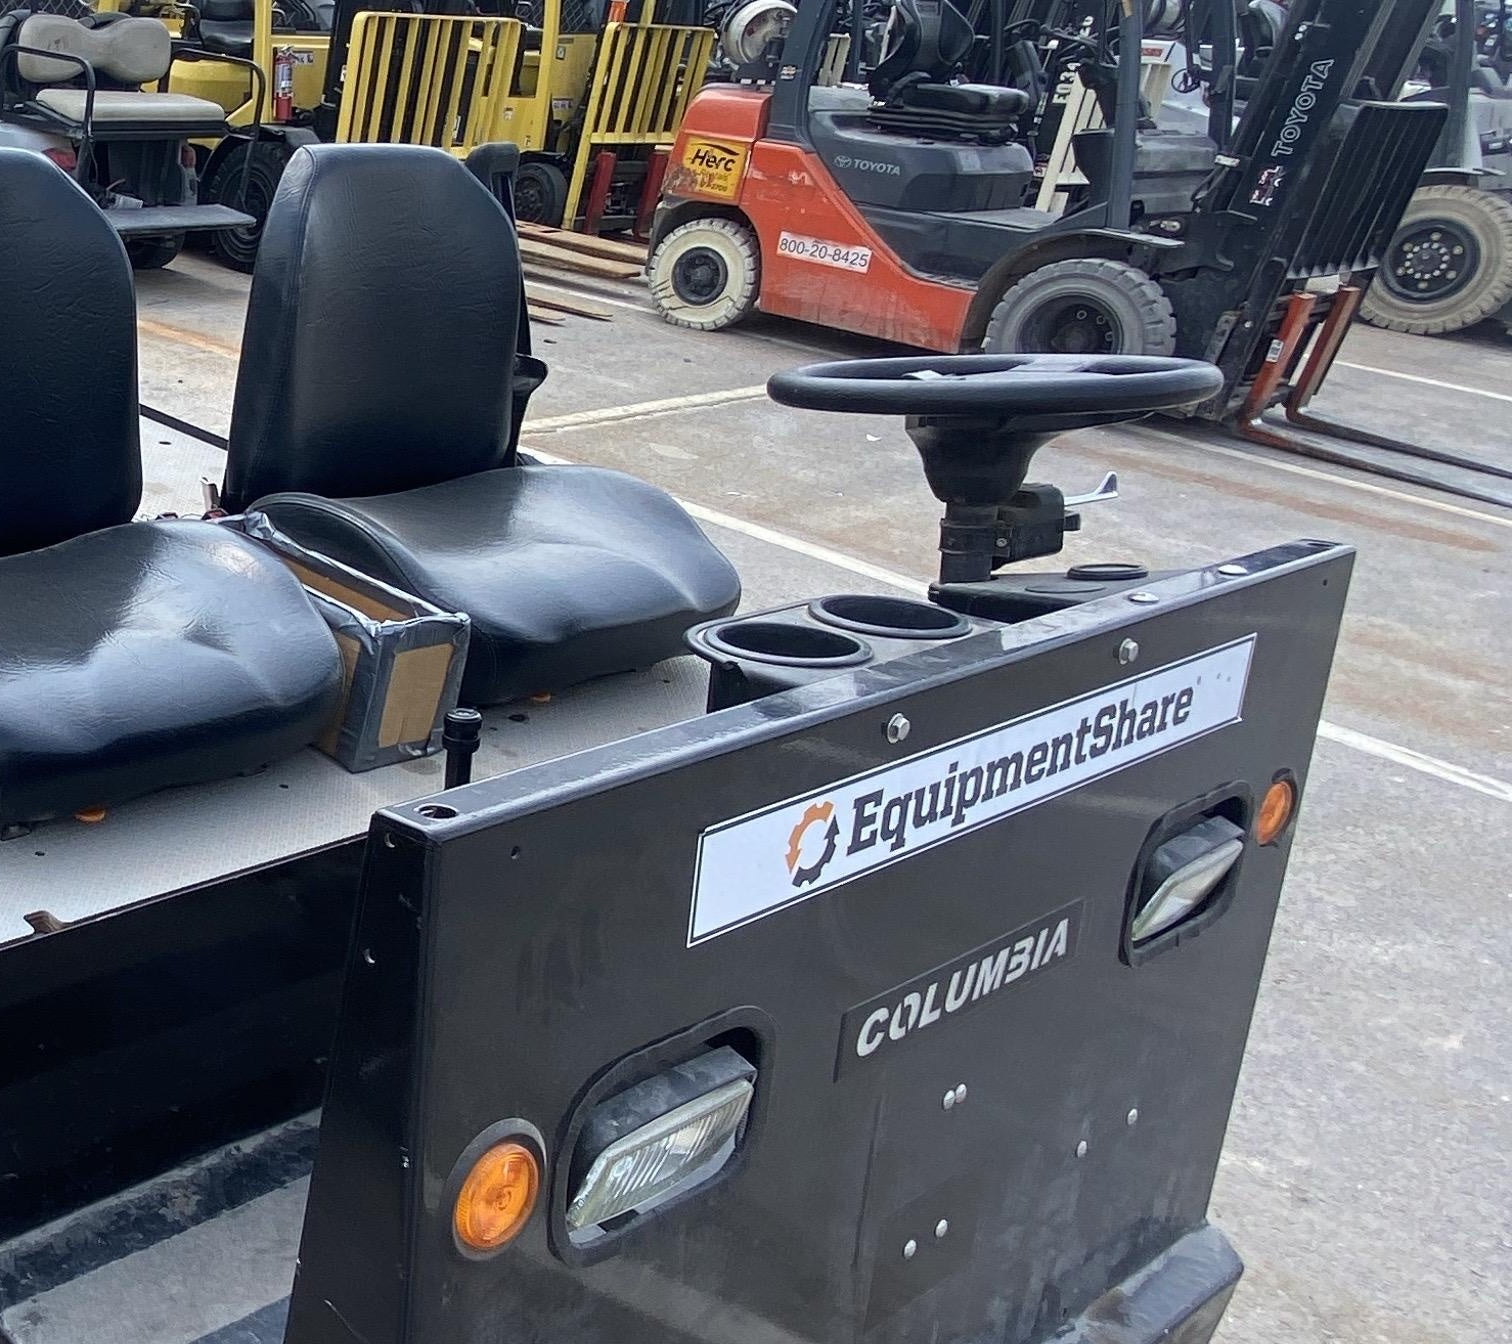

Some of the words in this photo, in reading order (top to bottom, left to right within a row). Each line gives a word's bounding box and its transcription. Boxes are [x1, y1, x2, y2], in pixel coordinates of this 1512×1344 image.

[1271, 58, 1334, 156] TOYOTA
[691, 148, 736, 172] Herc
[853, 159, 901, 176] TOYOTA
[779, 238, 869, 268] 800-20-8425
[845, 686, 1194, 850] EquipmentShare
[855, 918, 1070, 1057] COLUMBIA
